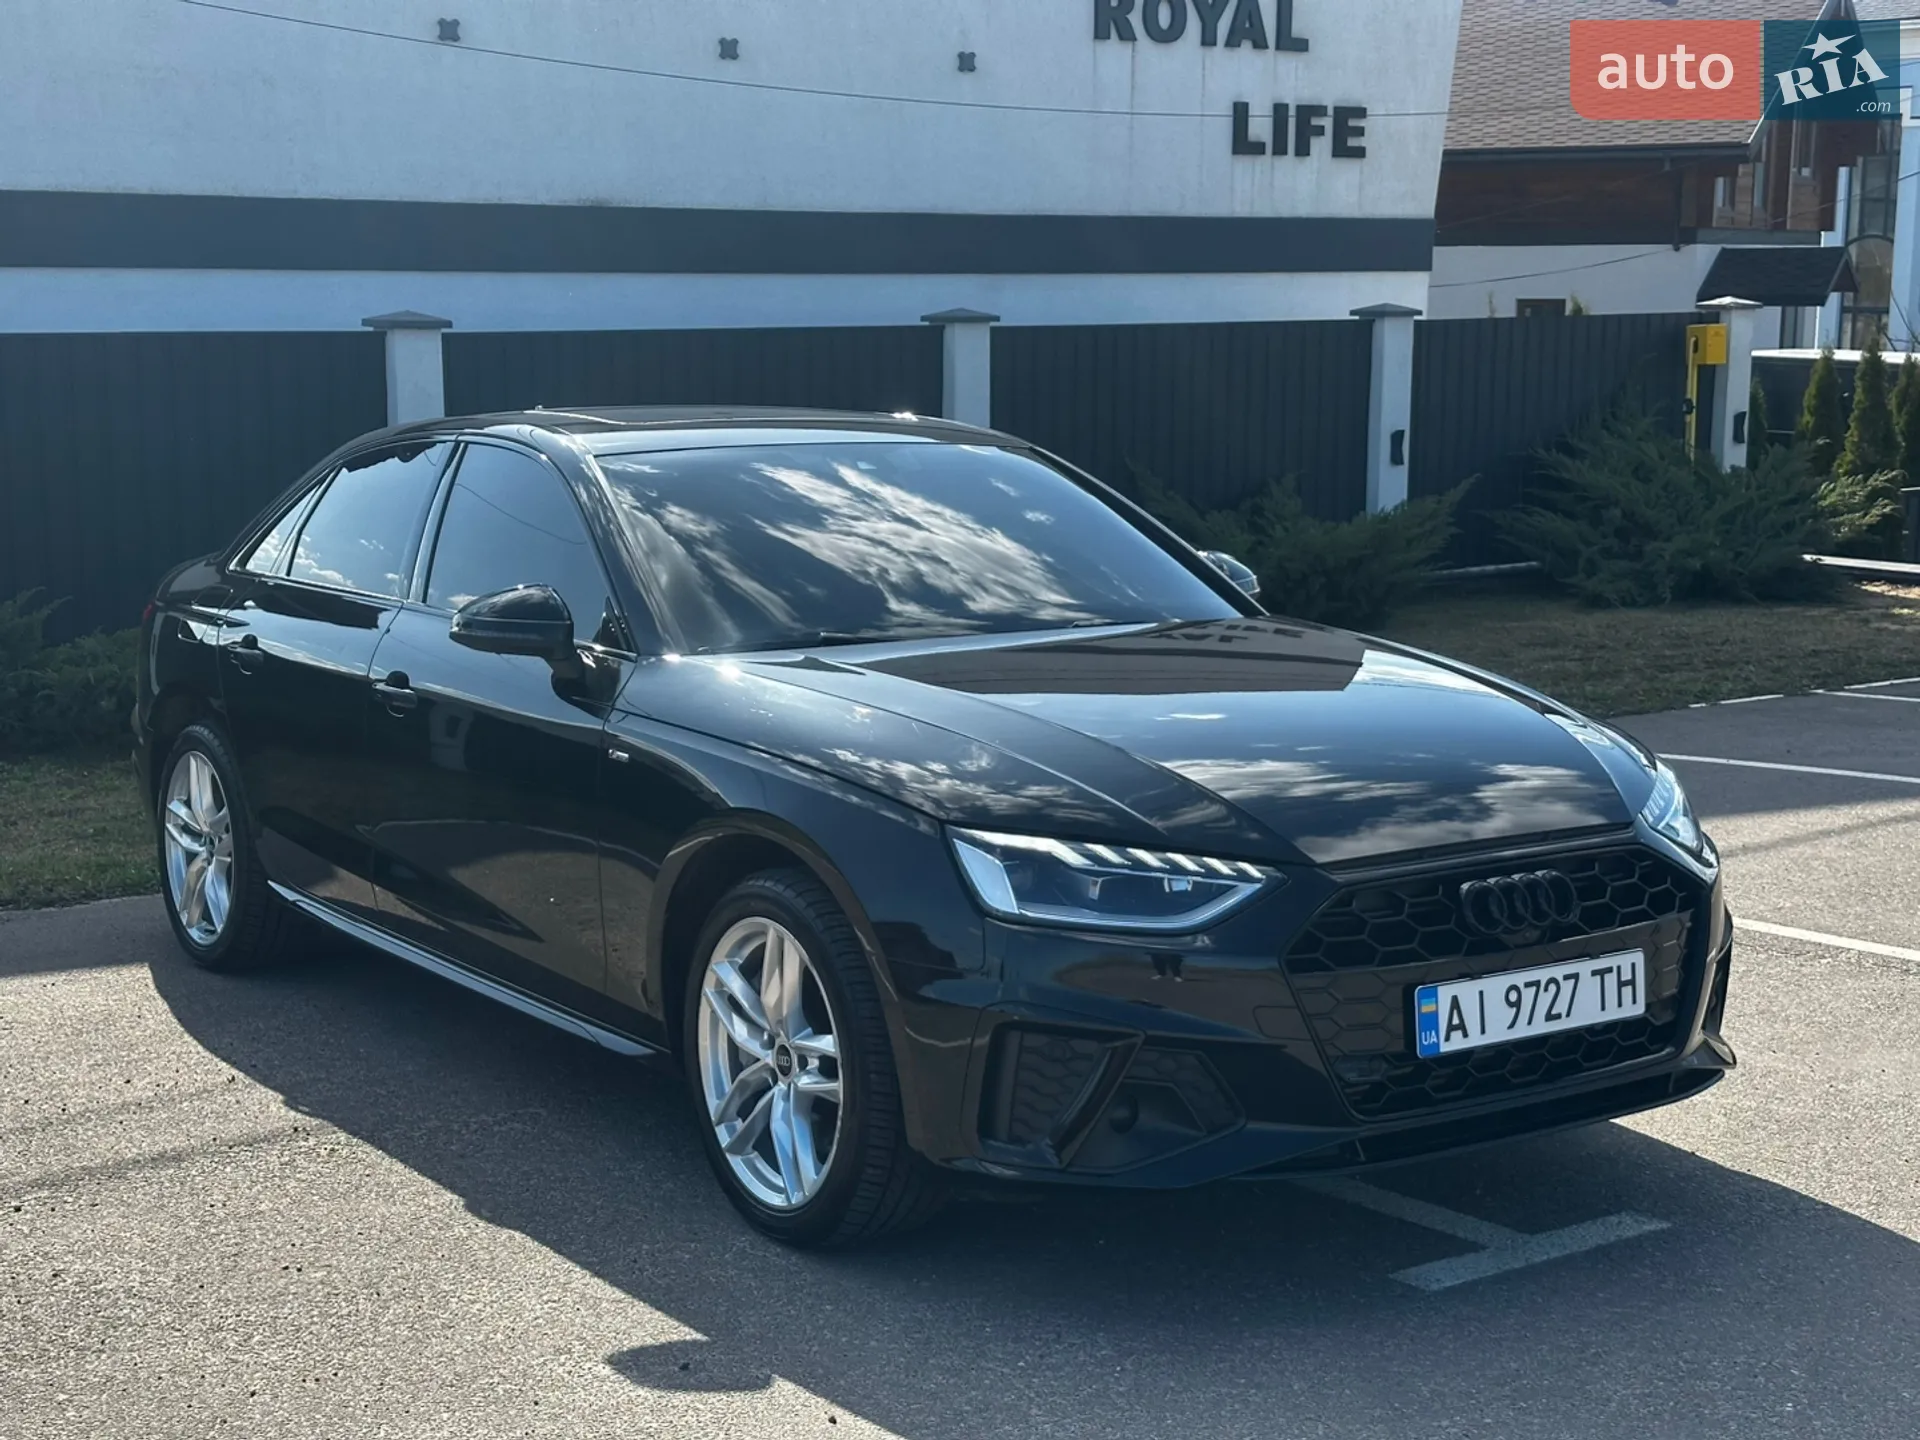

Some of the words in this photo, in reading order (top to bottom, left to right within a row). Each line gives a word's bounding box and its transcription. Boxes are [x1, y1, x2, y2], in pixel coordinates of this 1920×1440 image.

[1093, 0, 1309, 52] ROYAL
[1231, 101, 1368, 158] LIFE
[1444, 989, 1486, 1042] AI
[1504, 972, 1580, 1030] 9727
[1591, 962, 1637, 1012] TH
[1421, 1030, 1438, 1045] UA
